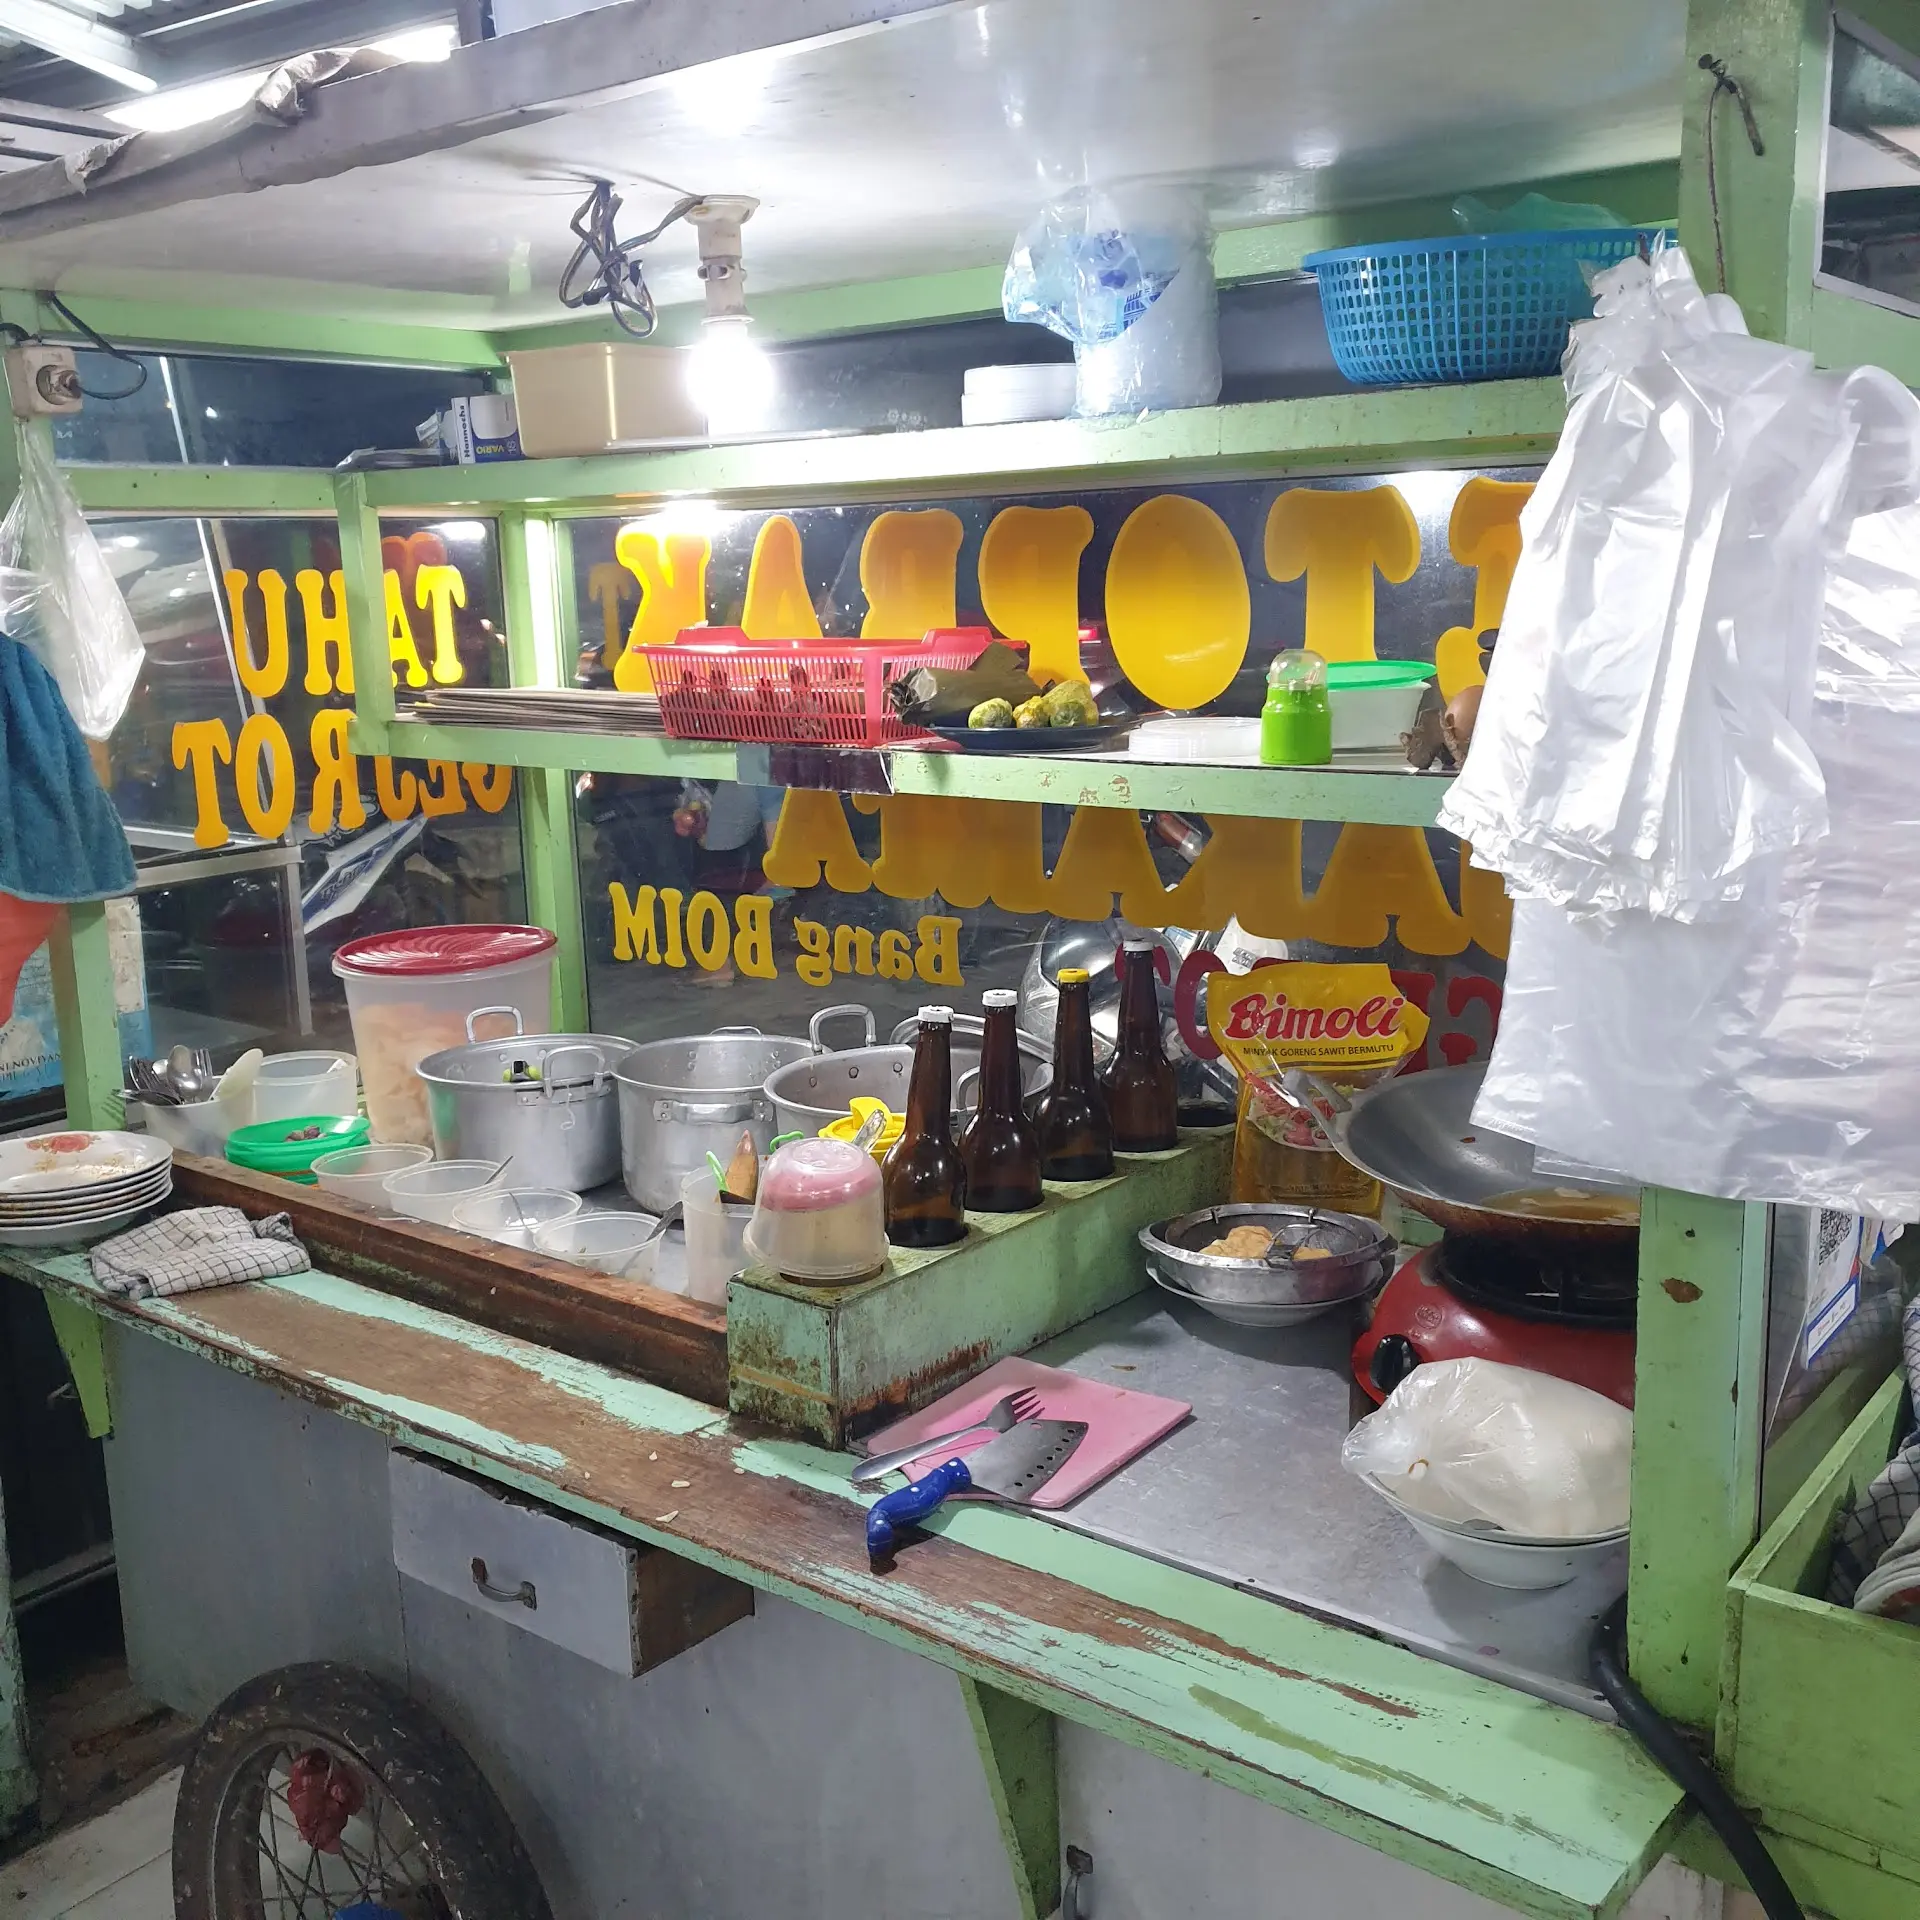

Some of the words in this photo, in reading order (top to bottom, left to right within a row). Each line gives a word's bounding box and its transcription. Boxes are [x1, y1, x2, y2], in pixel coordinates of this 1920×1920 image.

[476, 445, 505, 455] VARIO
[1225, 993, 1406, 1041] Bimoli
[1243, 1045, 1278, 1056] MINYAK
[1280, 1046, 1317, 1057] GORENG
[1318, 1046, 1346, 1056] SAWIT
[1348, 1044, 1394, 1055] BERMUTU
